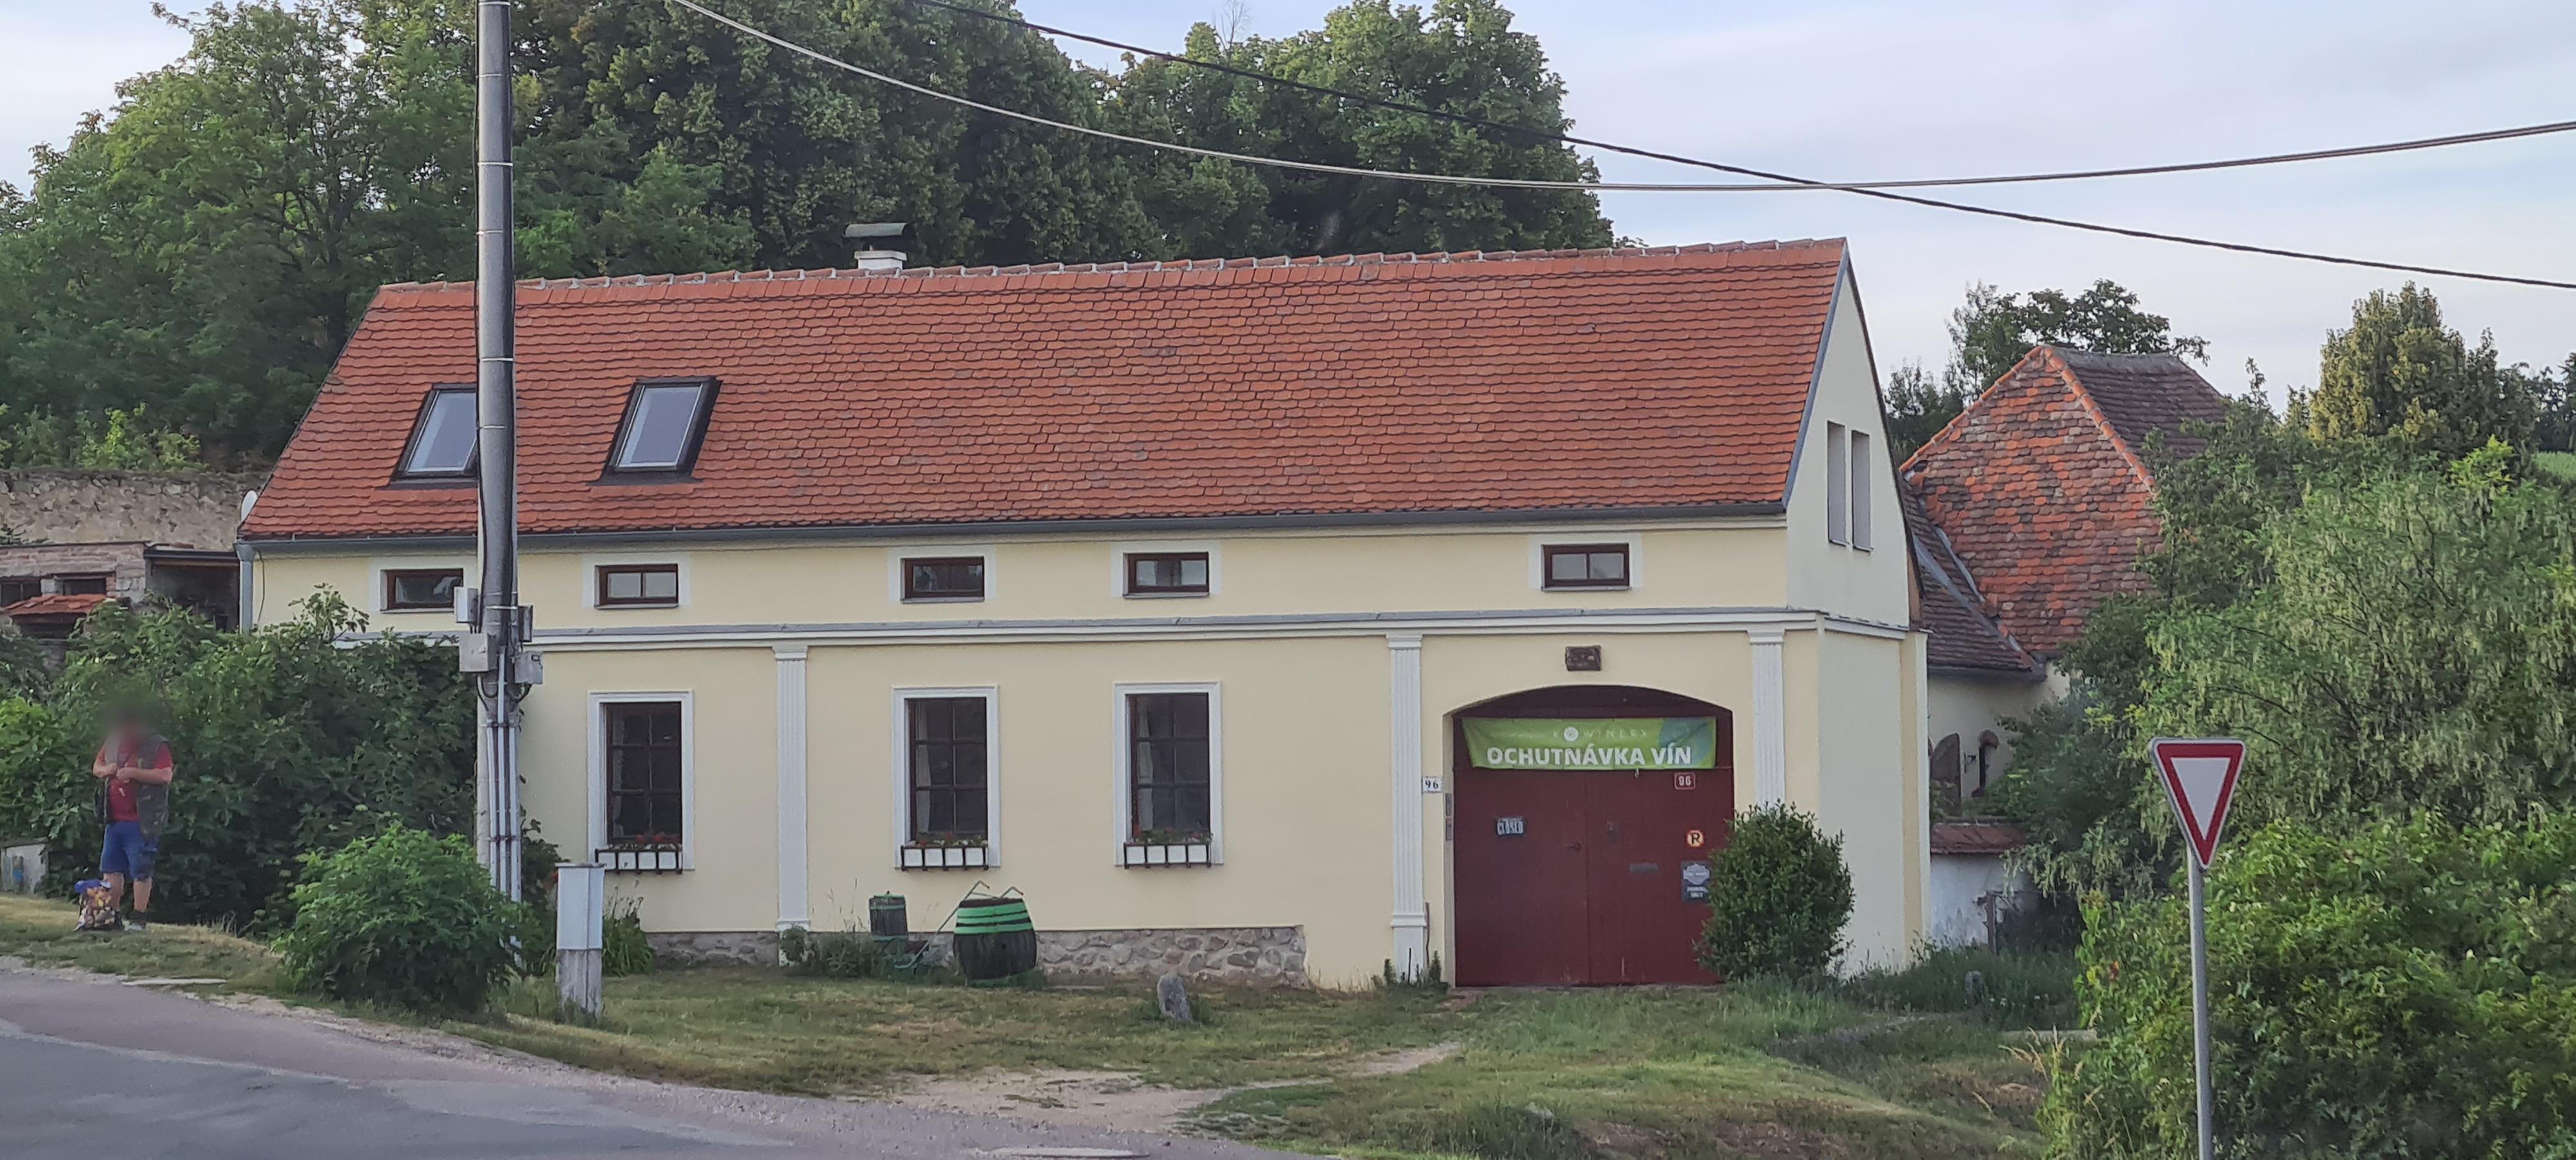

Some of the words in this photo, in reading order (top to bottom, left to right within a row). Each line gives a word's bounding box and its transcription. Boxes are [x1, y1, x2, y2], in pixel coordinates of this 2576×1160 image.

[1486, 743, 1646, 765] OCHUTNÁVKA
[1651, 742, 1692, 765] VÍN
[1425, 779, 1439, 789] 96
[1678, 775, 1692, 786] 96
[1691, 832, 1700, 845] R
